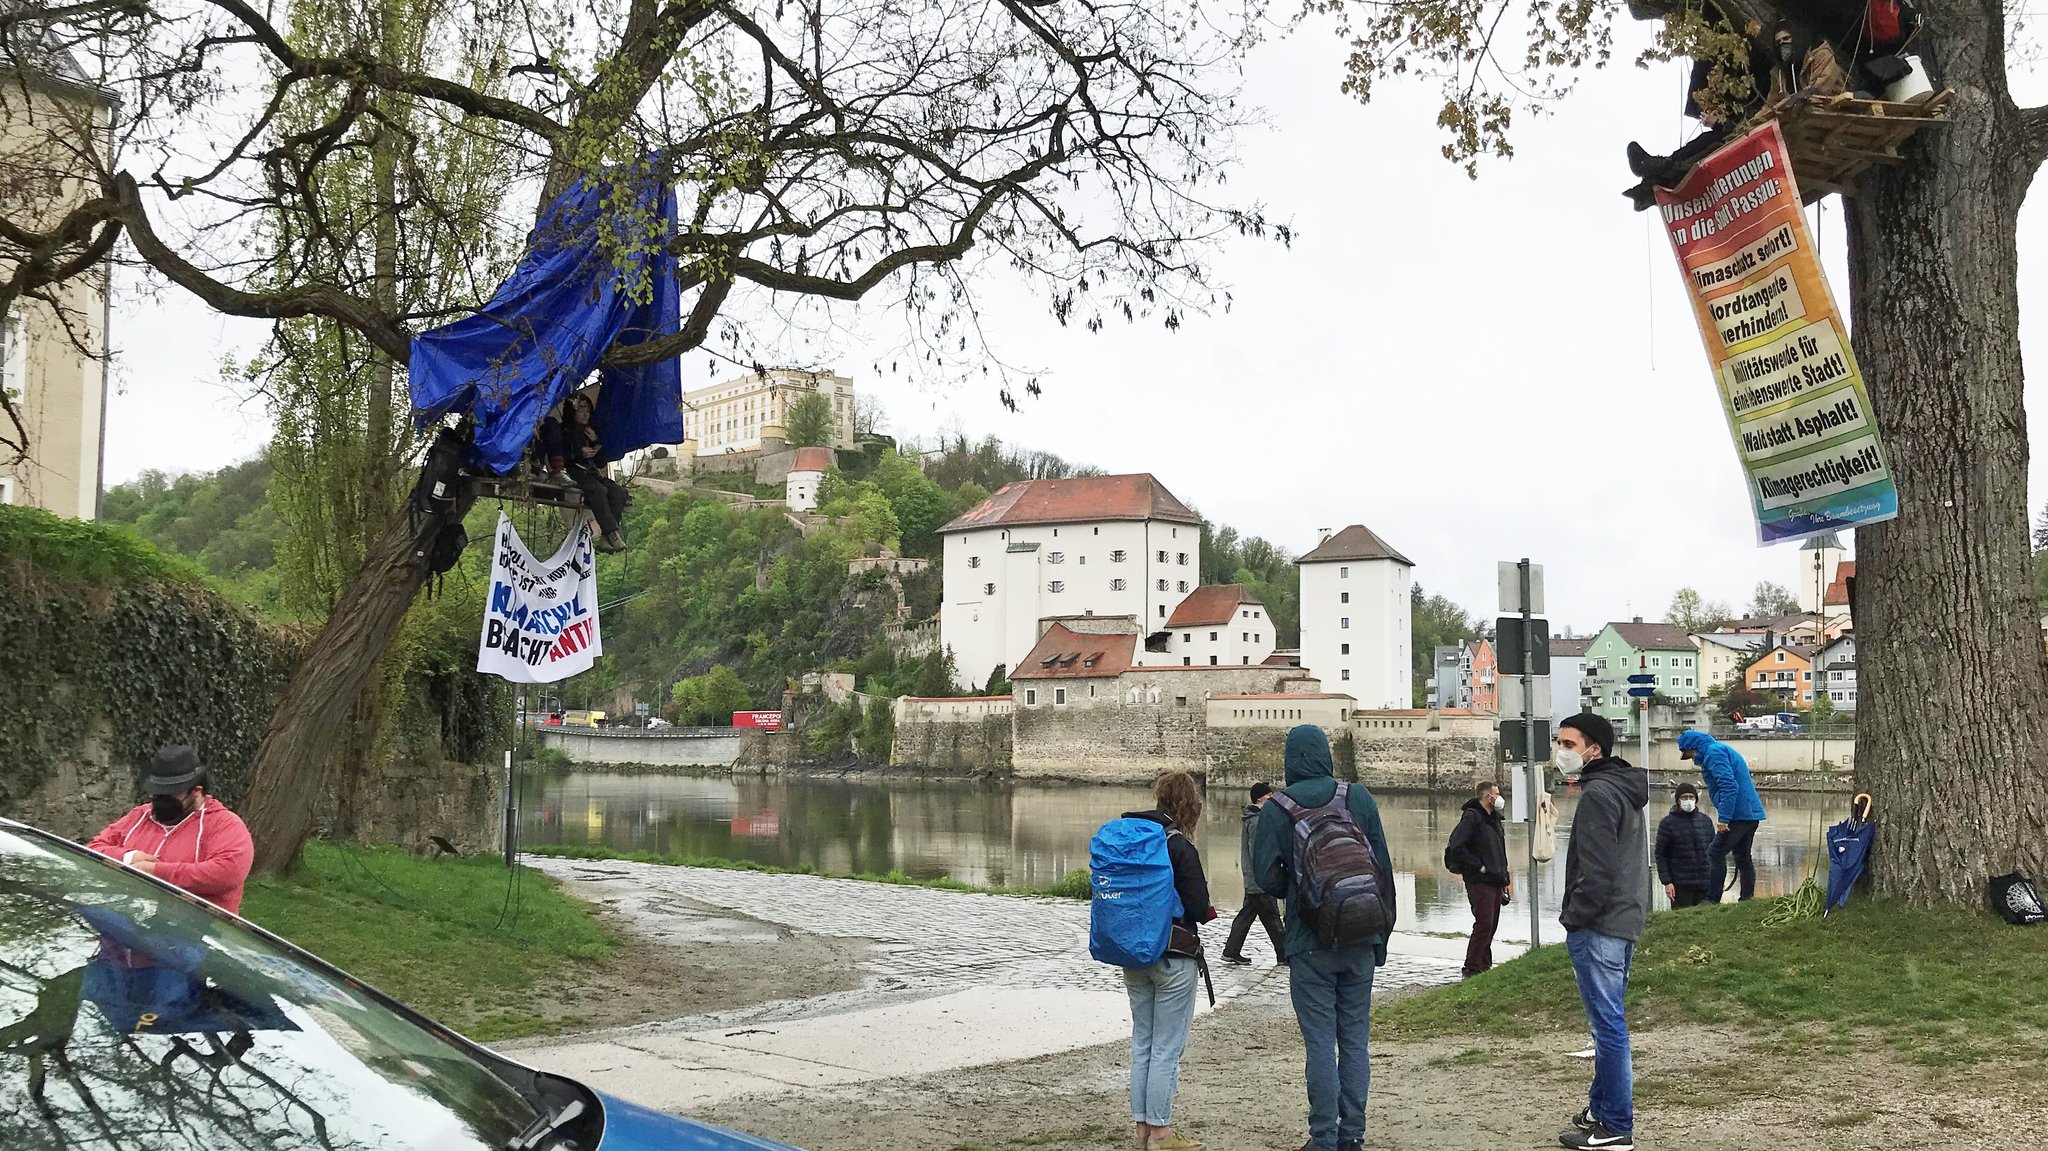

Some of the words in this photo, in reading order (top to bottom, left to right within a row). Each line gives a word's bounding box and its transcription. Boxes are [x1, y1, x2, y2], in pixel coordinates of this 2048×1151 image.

[1691, 217, 1716, 241] die
[1730, 178, 1782, 218] Passau:
[1694, 252, 1757, 289] limaschutz
[1721, 301, 1789, 344] verhindern!
[1798, 335, 1819, 358] für
[1801, 352, 1846, 387] Stadt!
[1795, 398, 1859, 437] Asphalt!
[1758, 445, 1882, 499] Klimagerechtigkeit!
